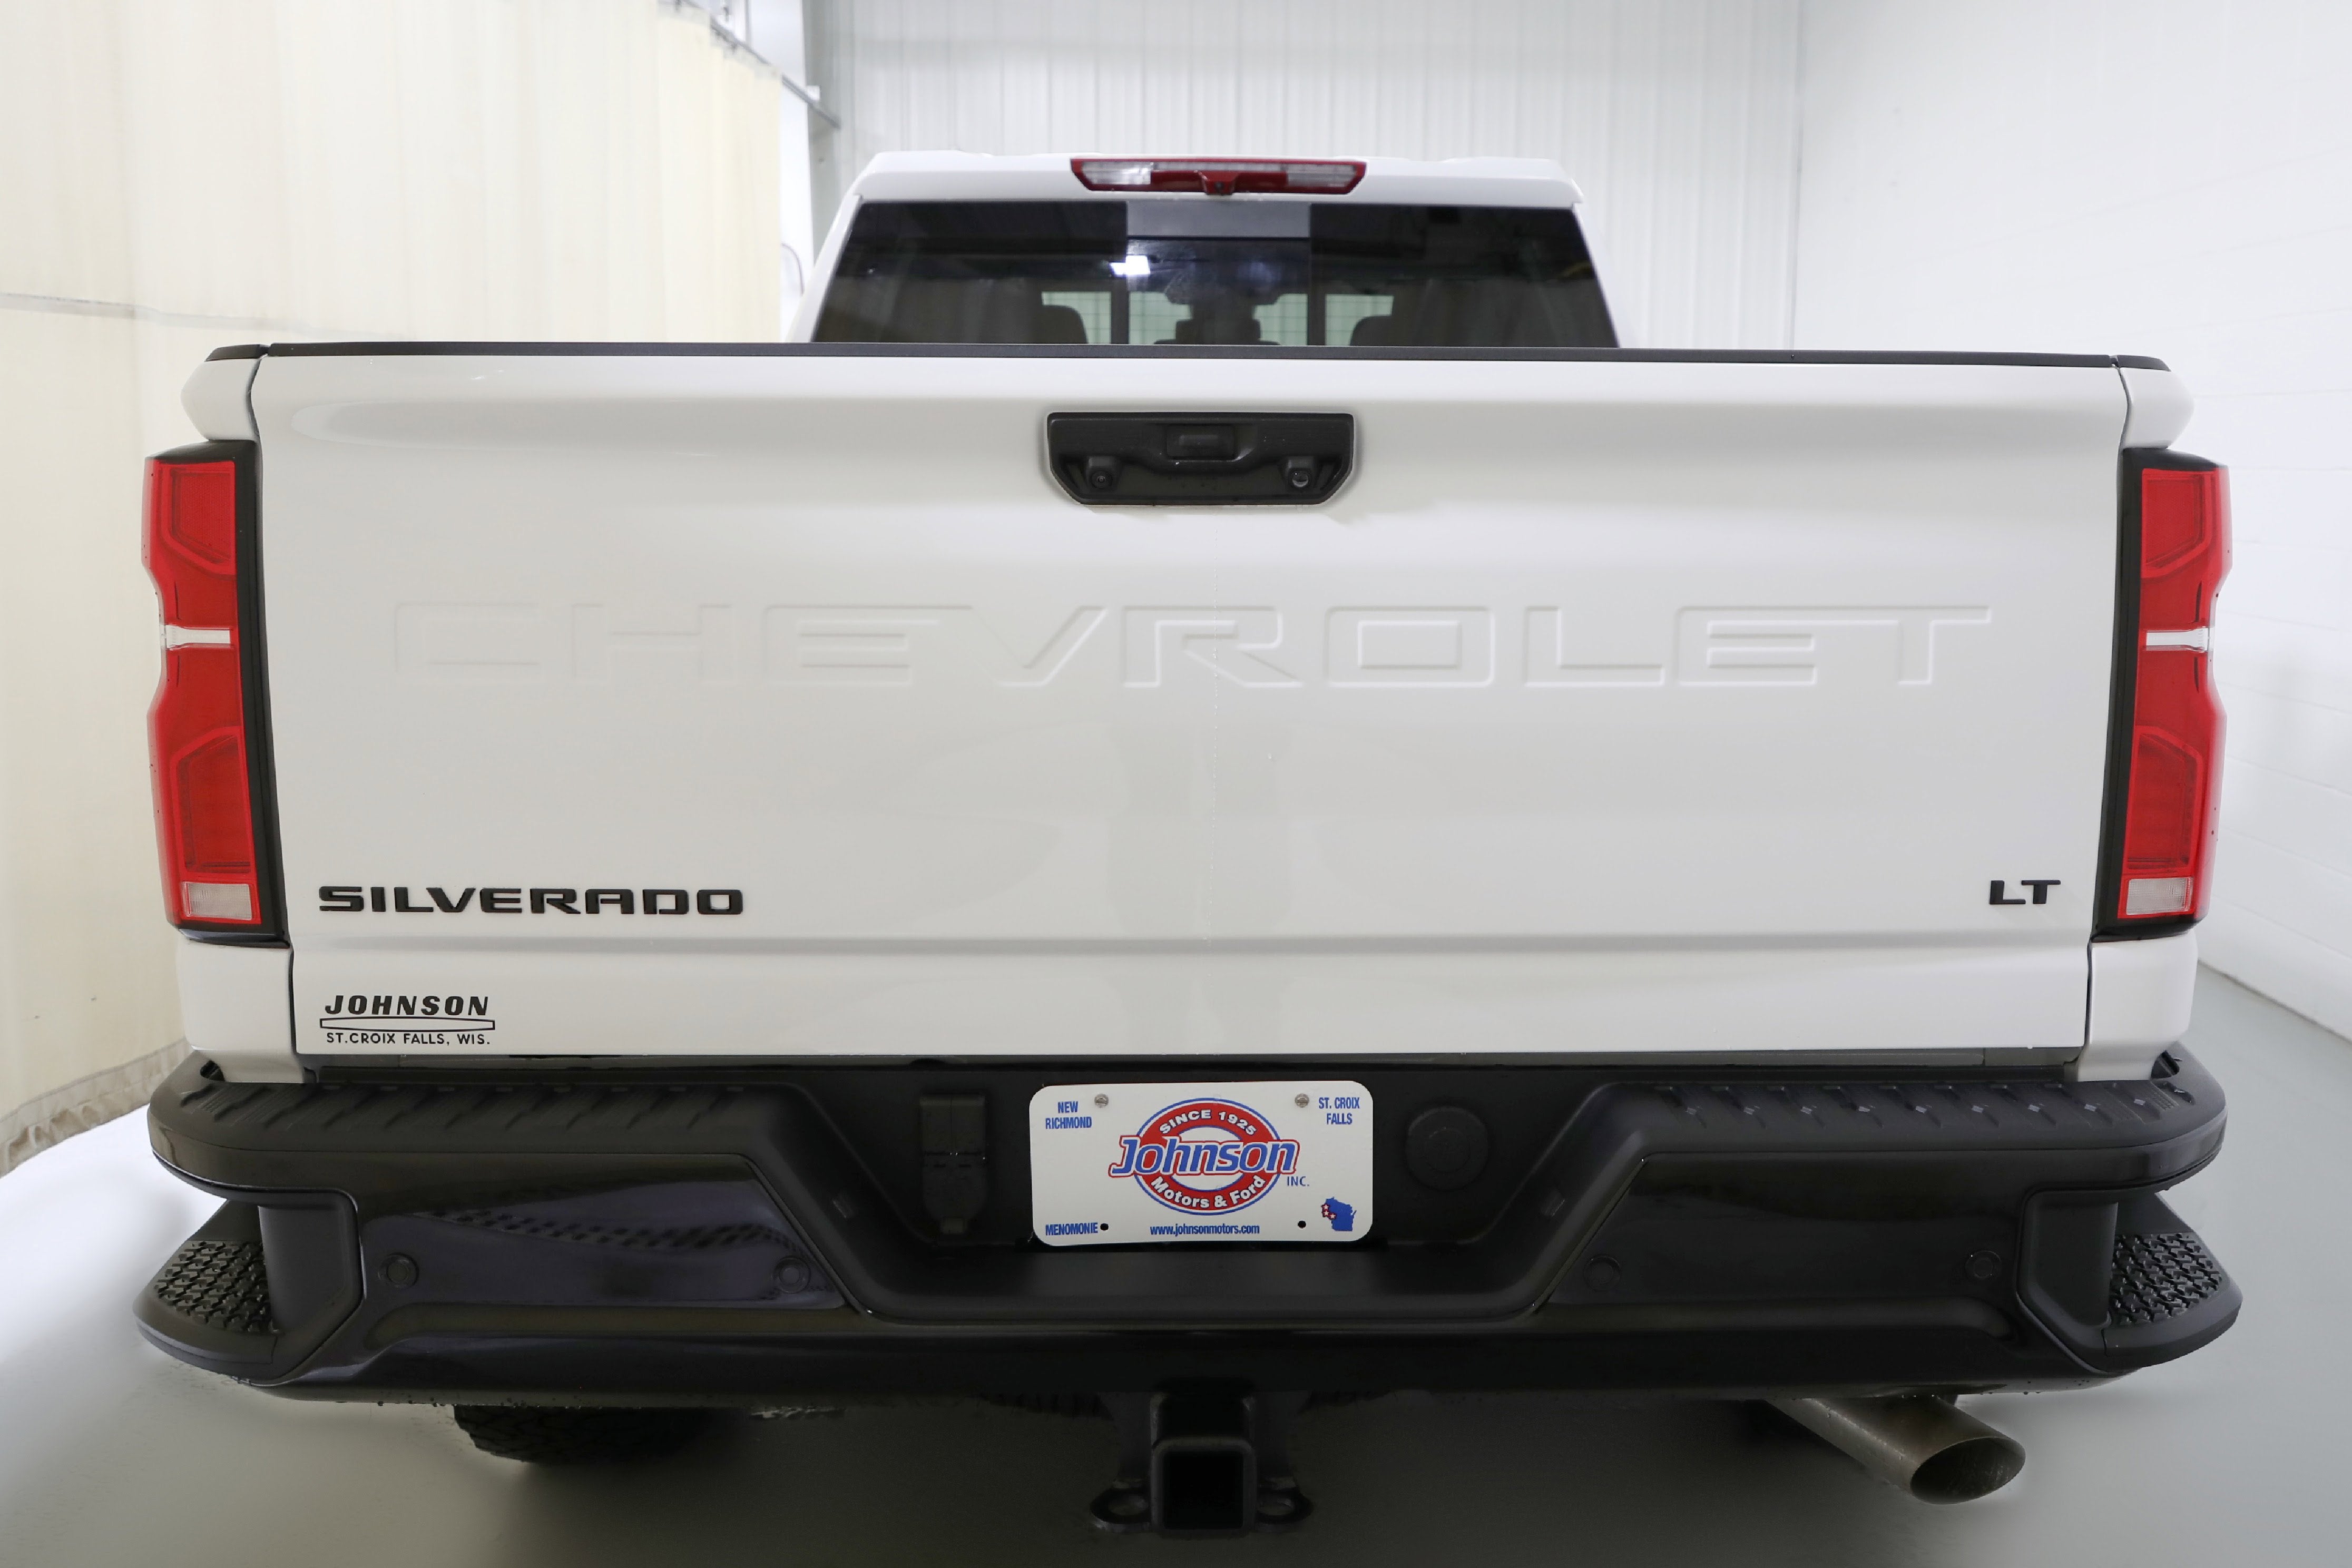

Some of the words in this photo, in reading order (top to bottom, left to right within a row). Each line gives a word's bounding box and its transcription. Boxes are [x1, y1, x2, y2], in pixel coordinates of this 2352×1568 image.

[393, 603, 1993, 691] CHEVROLET
[1988, 879, 2061, 905] LT
[318, 885, 744, 916] SILVERADO
[325, 995, 489, 1016] JOHNSON
[403, 1033, 449, 1046] FALLS,
[457, 1033, 491, 1045] WIS.
[1057, 1101, 1079, 1114] NEW
[1318, 1097, 1332, 1109] ST.
[1335, 1096, 1360, 1109] CROIX
[1045, 1116, 1092, 1130] RICHMOND
[1159, 1109, 1211, 1134] SINCE
[1218, 1111, 1258, 1135] 1925
[1326, 1113, 1353, 1125] FALLS
[1111, 1138, 1296, 1174] Johnson
[1287, 1175, 1310, 1187] INC.
[1151, 1176, 1210, 1209] Motors
[1214, 1195, 1228, 1208] &
[1229, 1175, 1266, 1204] Ford
[1045, 1222, 1099, 1236] MENOMONIE
[1150, 1223, 1260, 1237] www.johnsonmotors.com
